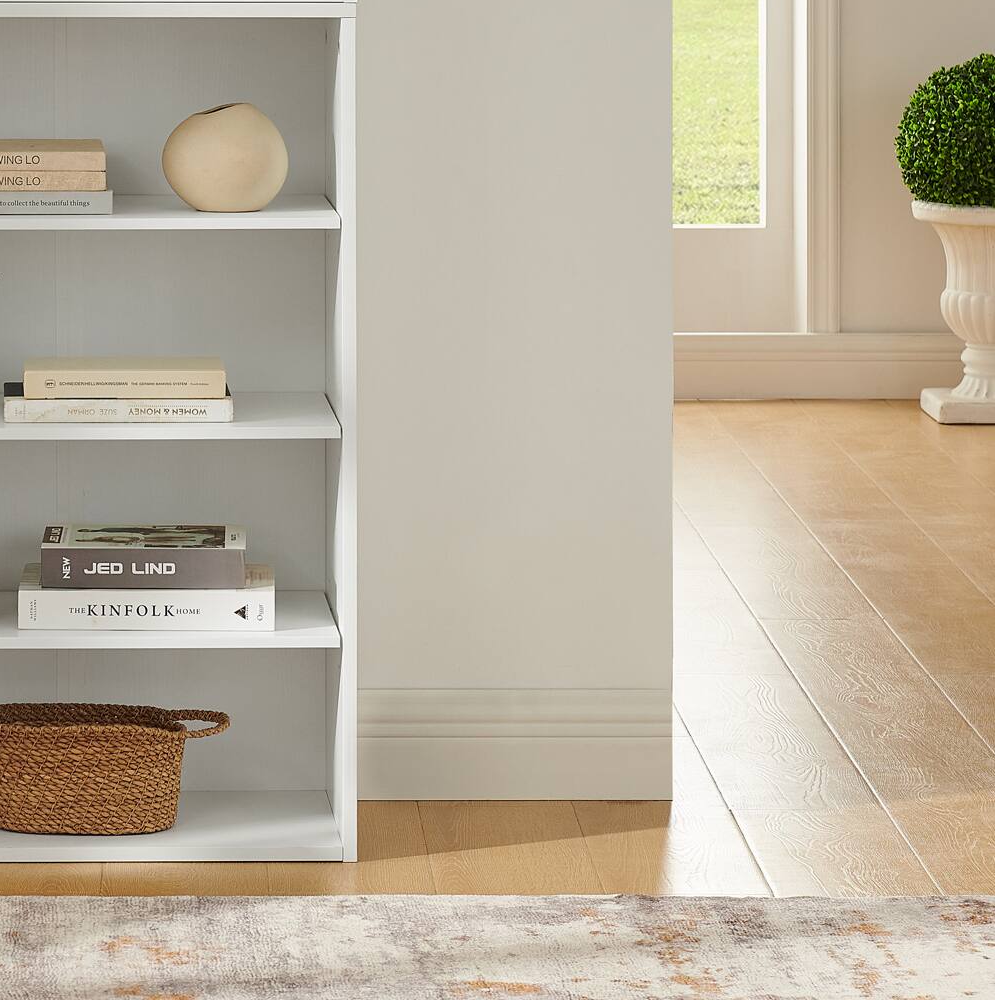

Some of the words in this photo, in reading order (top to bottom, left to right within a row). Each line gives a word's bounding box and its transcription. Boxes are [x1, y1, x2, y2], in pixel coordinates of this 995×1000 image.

[25, 156, 40, 165] LO
[26, 176, 41, 186] LO
[62, 557, 71, 579] NEW
[84, 562, 124, 574] JED
[131, 562, 176, 574] LIND
[87, 604, 174, 616] KINFOLK
